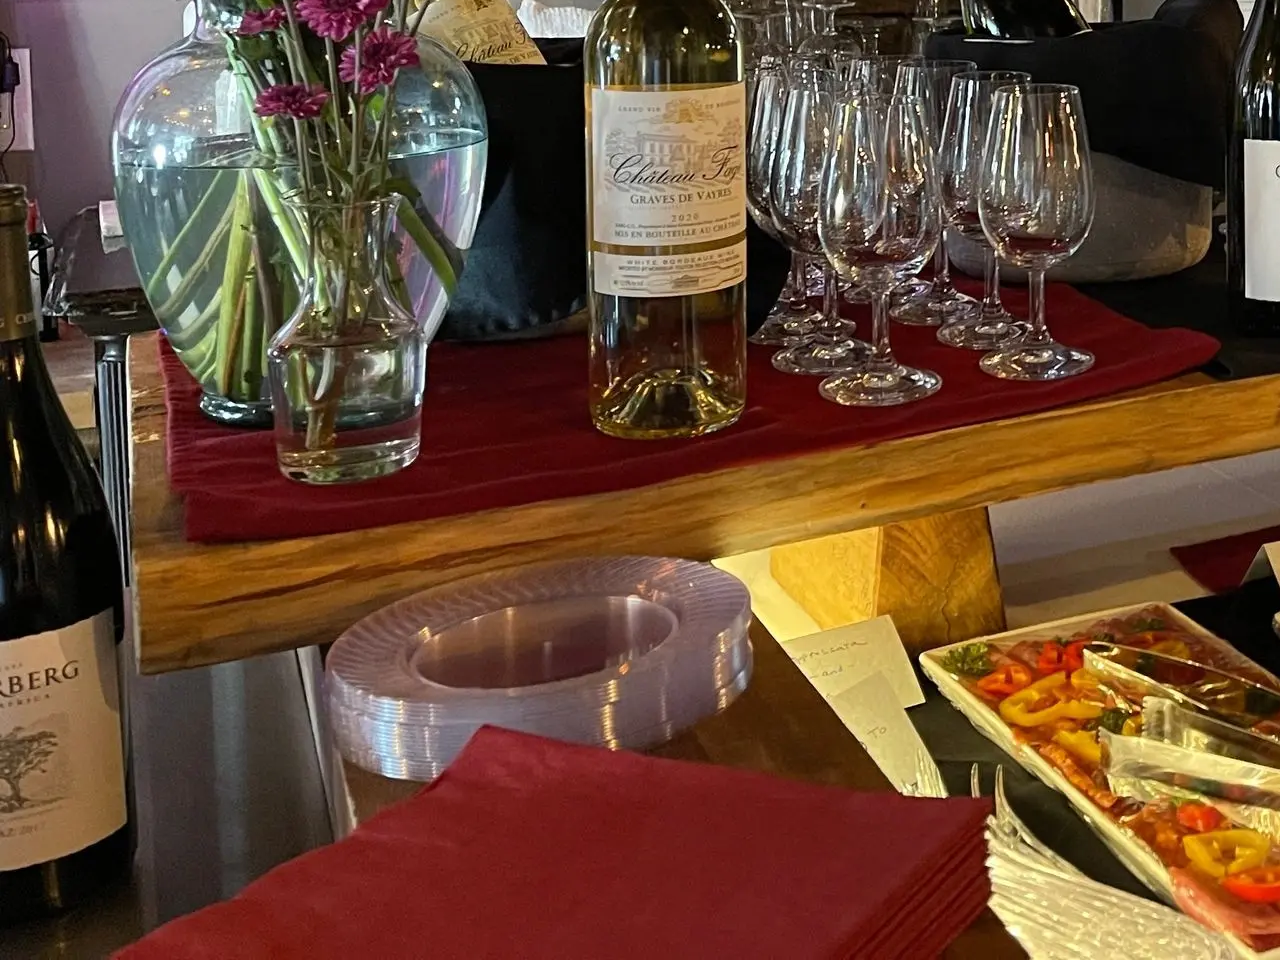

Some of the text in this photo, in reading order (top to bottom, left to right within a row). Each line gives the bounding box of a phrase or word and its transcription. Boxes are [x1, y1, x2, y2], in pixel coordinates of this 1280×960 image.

[608, 152, 696, 187] Château
[630, 187, 733, 205] GRAVES DE VAYRES
[671, 212, 700, 223] 2020
[631, 230, 643, 239] EN
[645, 228, 697, 239] BOUTEILLE
[700, 226, 712, 235] AU
[662, 254, 714, 266] BORDEAUX
